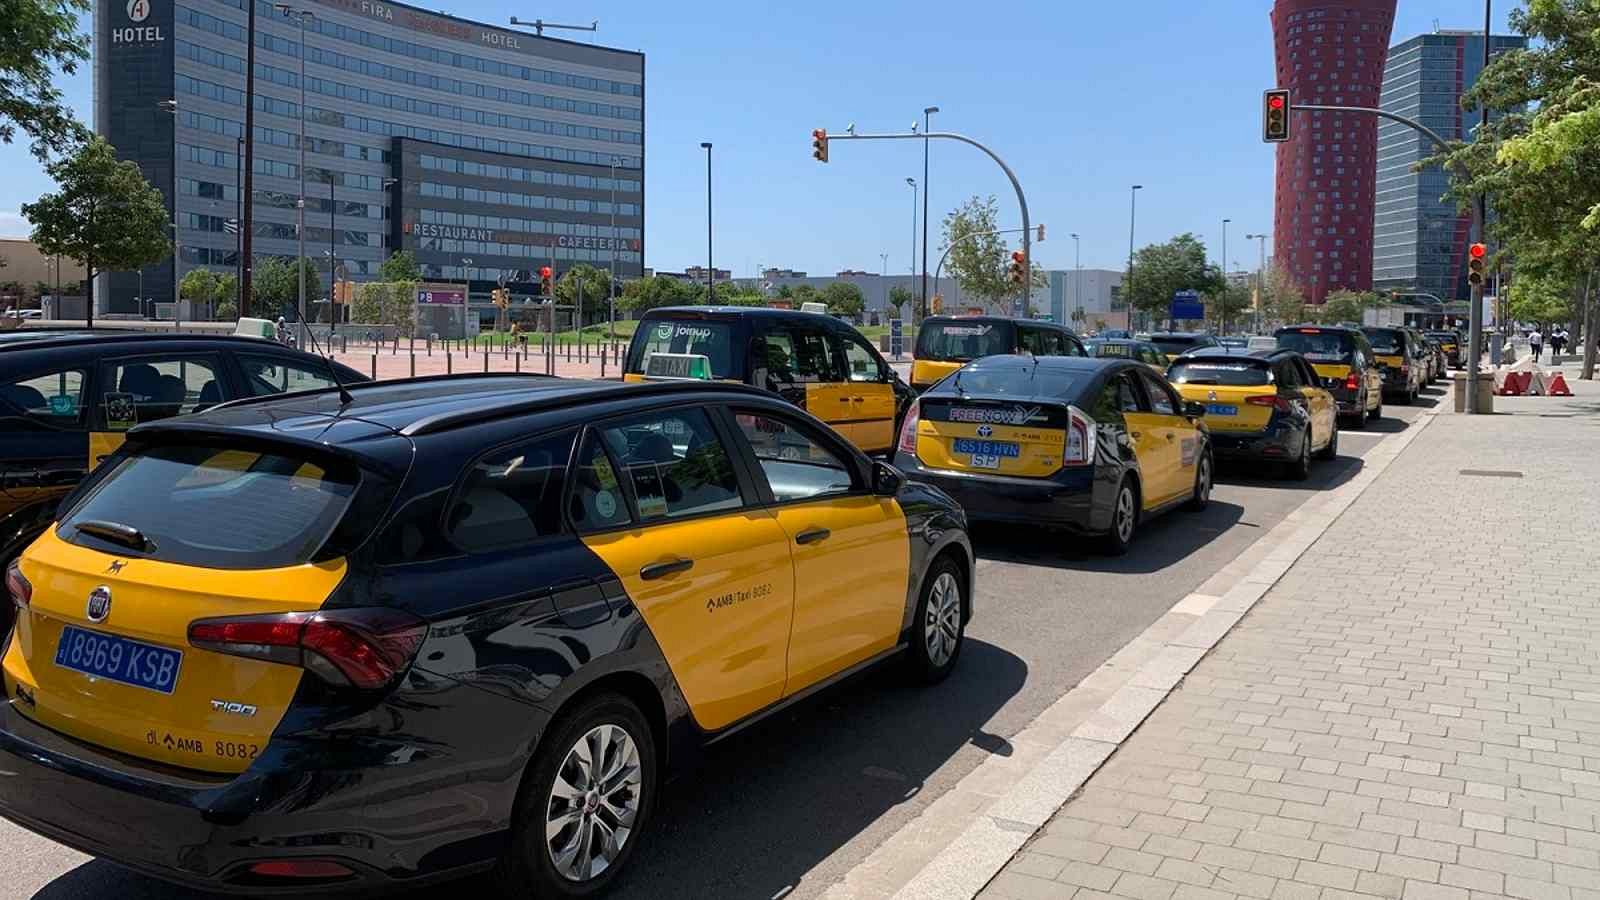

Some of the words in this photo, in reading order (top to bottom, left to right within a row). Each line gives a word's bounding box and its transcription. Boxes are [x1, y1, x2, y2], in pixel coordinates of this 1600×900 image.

[361, 1, 393, 20] FIRA
[481, 31, 521, 49] HOTEL
[112, 26, 165, 43] HOTEL
[413, 223, 493, 241] RESTAURANT
[558, 236, 628, 250] CAFETERIA
[674, 324, 711, 338] joinup
[664, 359, 689, 377] TAXI
[949, 408, 1016, 424] FREENOW
[71, 633, 123, 674] 8969
[125, 646, 175, 687] KSB
[210, 699, 257, 716] TIPO
[176, 738, 203, 753] AMB
[215, 741, 258, 759] 8082
